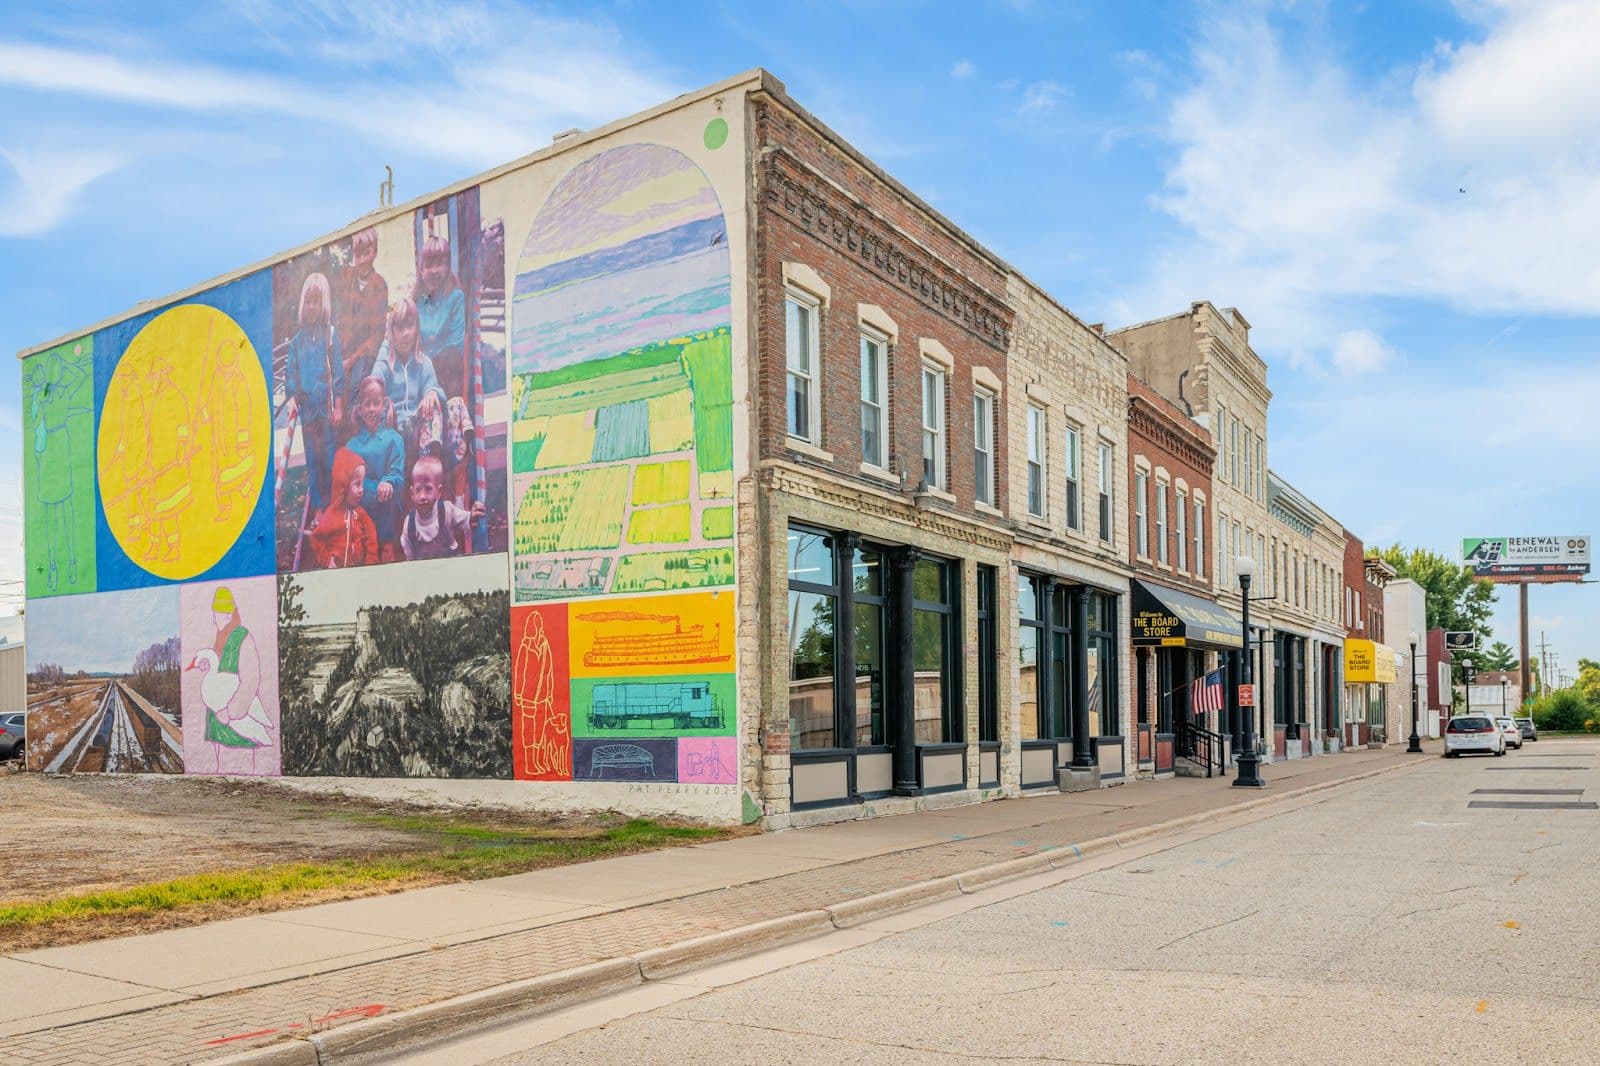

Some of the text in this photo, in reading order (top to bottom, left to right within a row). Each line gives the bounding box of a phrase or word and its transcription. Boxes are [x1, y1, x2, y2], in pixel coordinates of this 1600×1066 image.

[1509, 537, 1560, 546] RENEWAL
[1133, 616, 1179, 627] THE BOARD
[1143, 626, 1171, 637] STORE
[628, 784, 738, 795] PAT PERRY 2025
